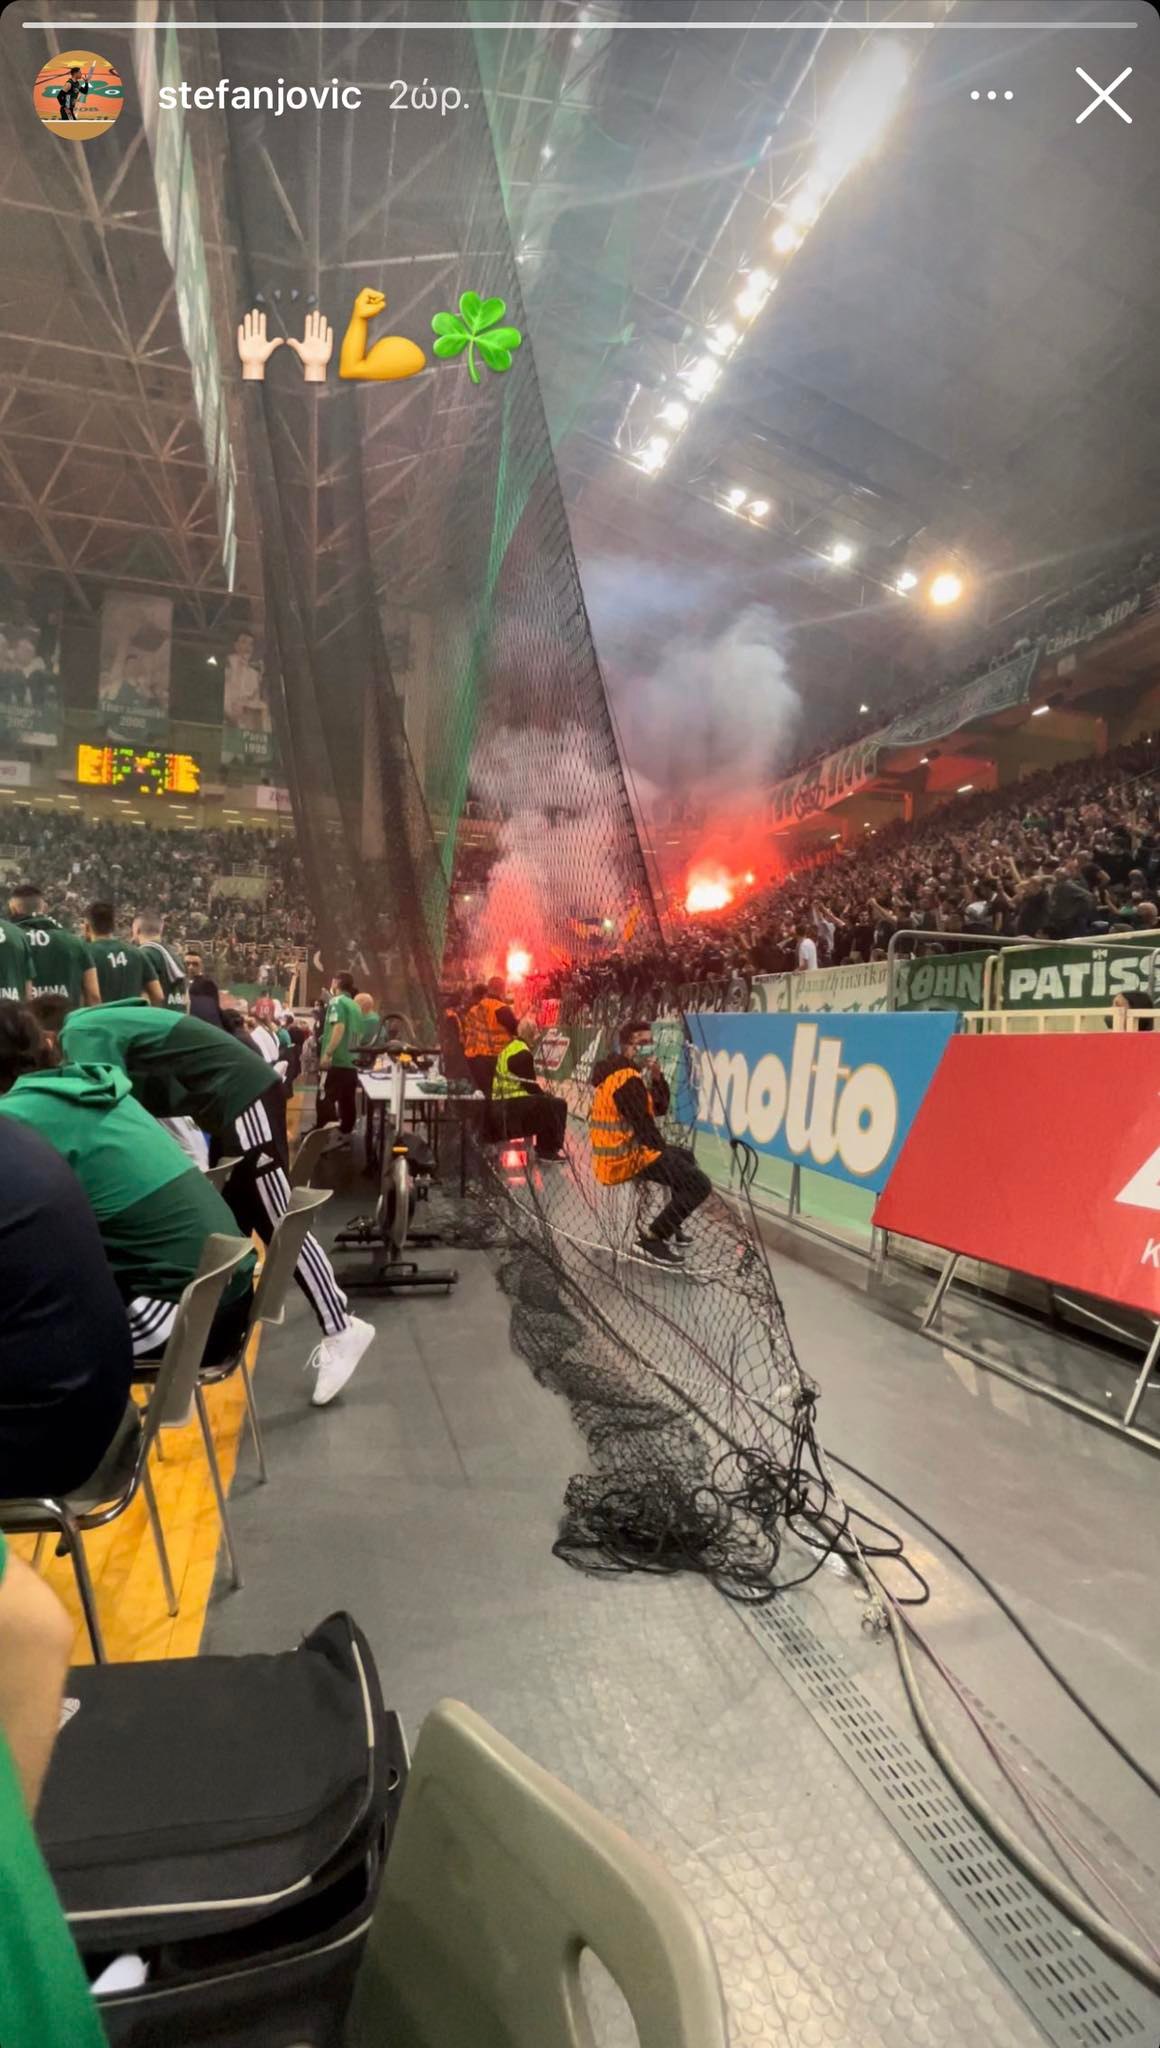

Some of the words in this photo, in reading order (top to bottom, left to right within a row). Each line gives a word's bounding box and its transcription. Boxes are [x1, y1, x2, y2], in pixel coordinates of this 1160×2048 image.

[26, 929, 50, 946] 10
[108, 951, 128, 968] 14
[697, 1022, 898, 1178] molto
